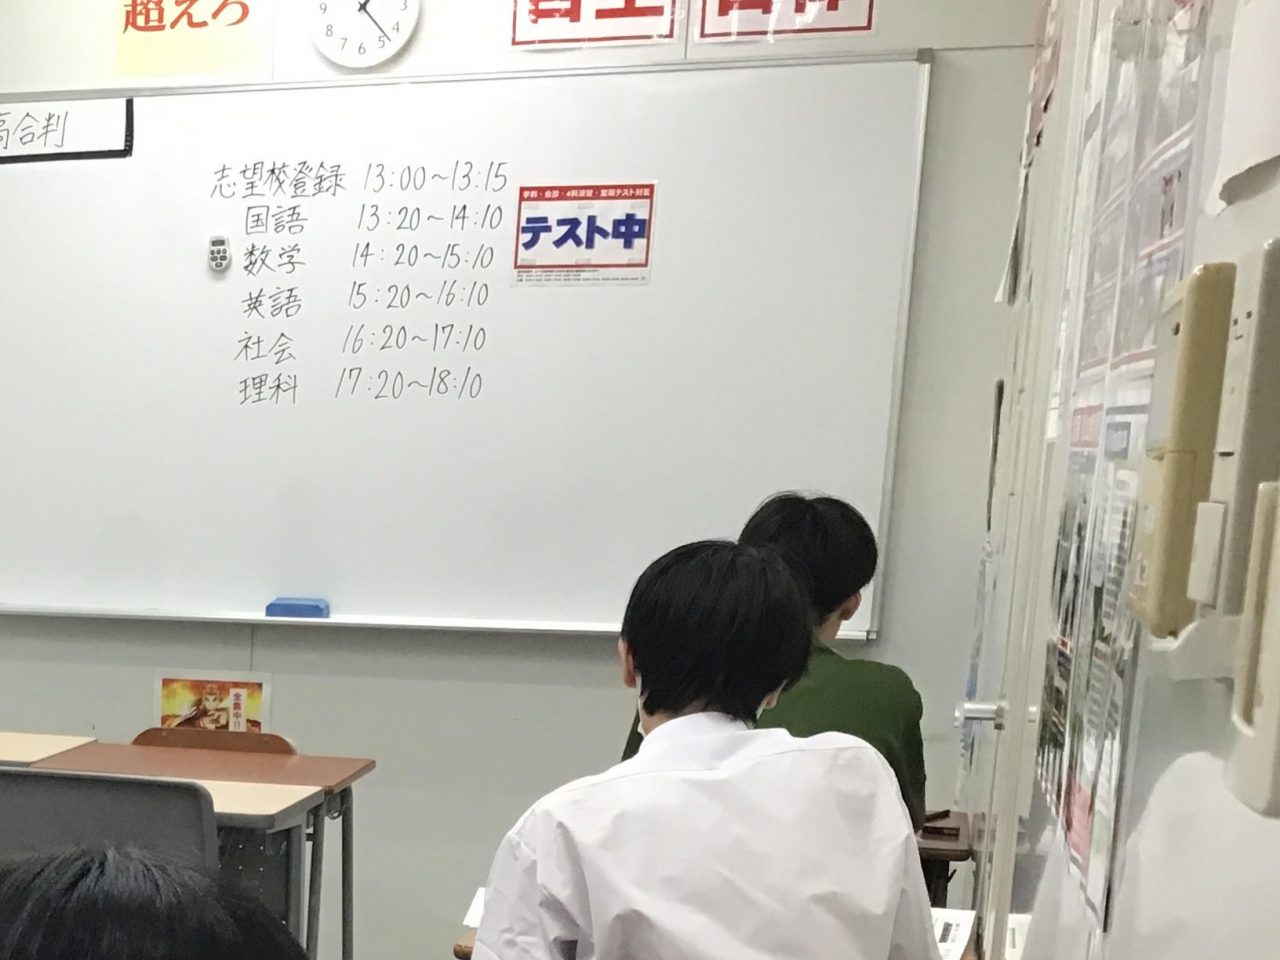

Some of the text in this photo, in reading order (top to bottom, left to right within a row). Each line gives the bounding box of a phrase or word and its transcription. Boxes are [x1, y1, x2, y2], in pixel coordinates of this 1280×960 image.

[320, 2, 327, 14] 9
[325, 24, 333, 37] 8
[377, 35, 386, 48] 5
[392, 21, 400, 33] 4
[340, 37, 348, 51] 7
[358, 42, 366, 55] 6
[210, 160, 347, 199] 志望校登録
[246, 204, 308, 235] 国語
[520, 212, 648, 251] テスト中
[243, 242, 306, 277] 数学
[241, 286, 302, 319] 英語
[234, 330, 297, 365] 社会
[238, 372, 299, 405] 理科
